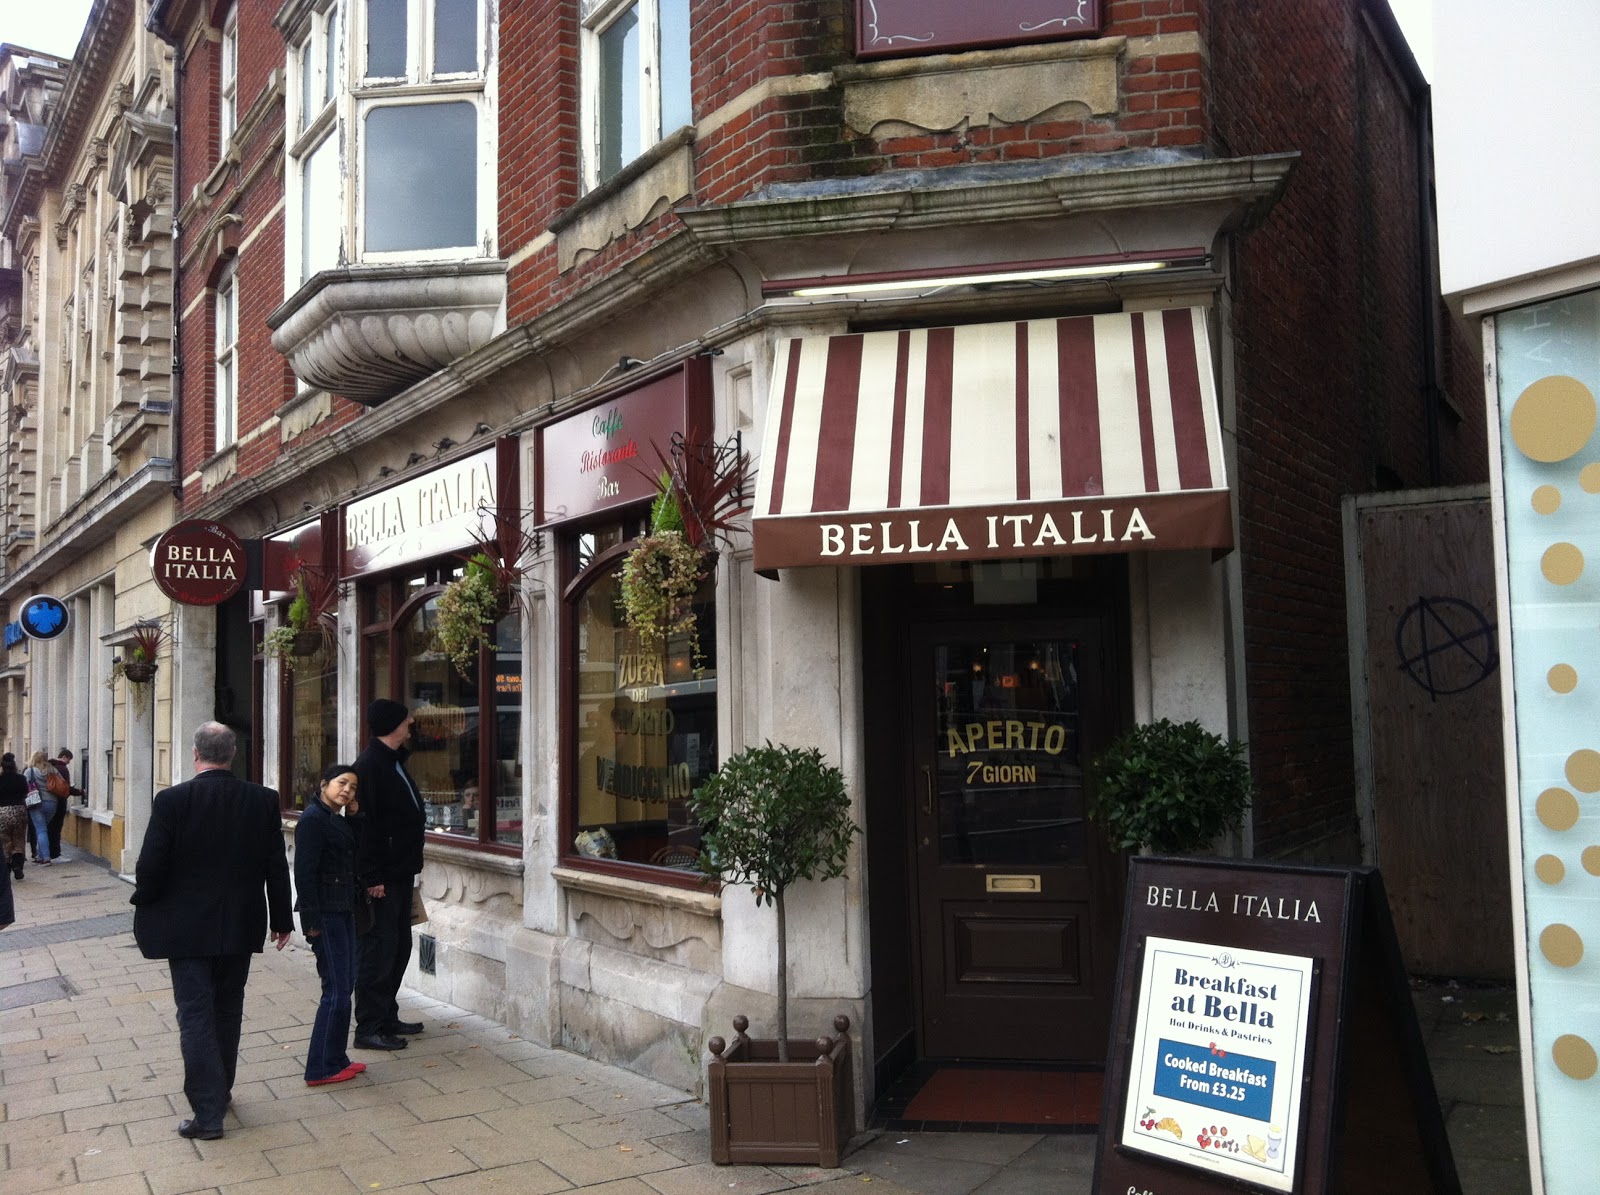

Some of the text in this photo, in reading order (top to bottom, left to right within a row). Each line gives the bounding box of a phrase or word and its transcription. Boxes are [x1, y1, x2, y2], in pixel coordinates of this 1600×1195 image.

[597, 475, 620, 500] Bar
[346, 462, 495, 551] BELLA ITALIA
[820, 507, 1156, 556] BELLA ITALIA
[168, 545, 236, 563] BELLA
[165, 563, 237, 580] ITALIA
[631, 688, 650, 703] DEL
[947, 720, 1066, 758] APERTO
[966, 761, 1037, 784] 7 GIORN
[1146, 886, 1321, 923] BELLA ITALIA
[1174, 967, 1278, 1001] Breakfast
[1171, 994, 1275, 1029] at Bella
[1169, 1018, 1273, 1045] Hot Drinks & Pastries
[1164, 1053, 1268, 1088] Cooked Breakfast
[1180, 1074, 1246, 1101] From £3.25
